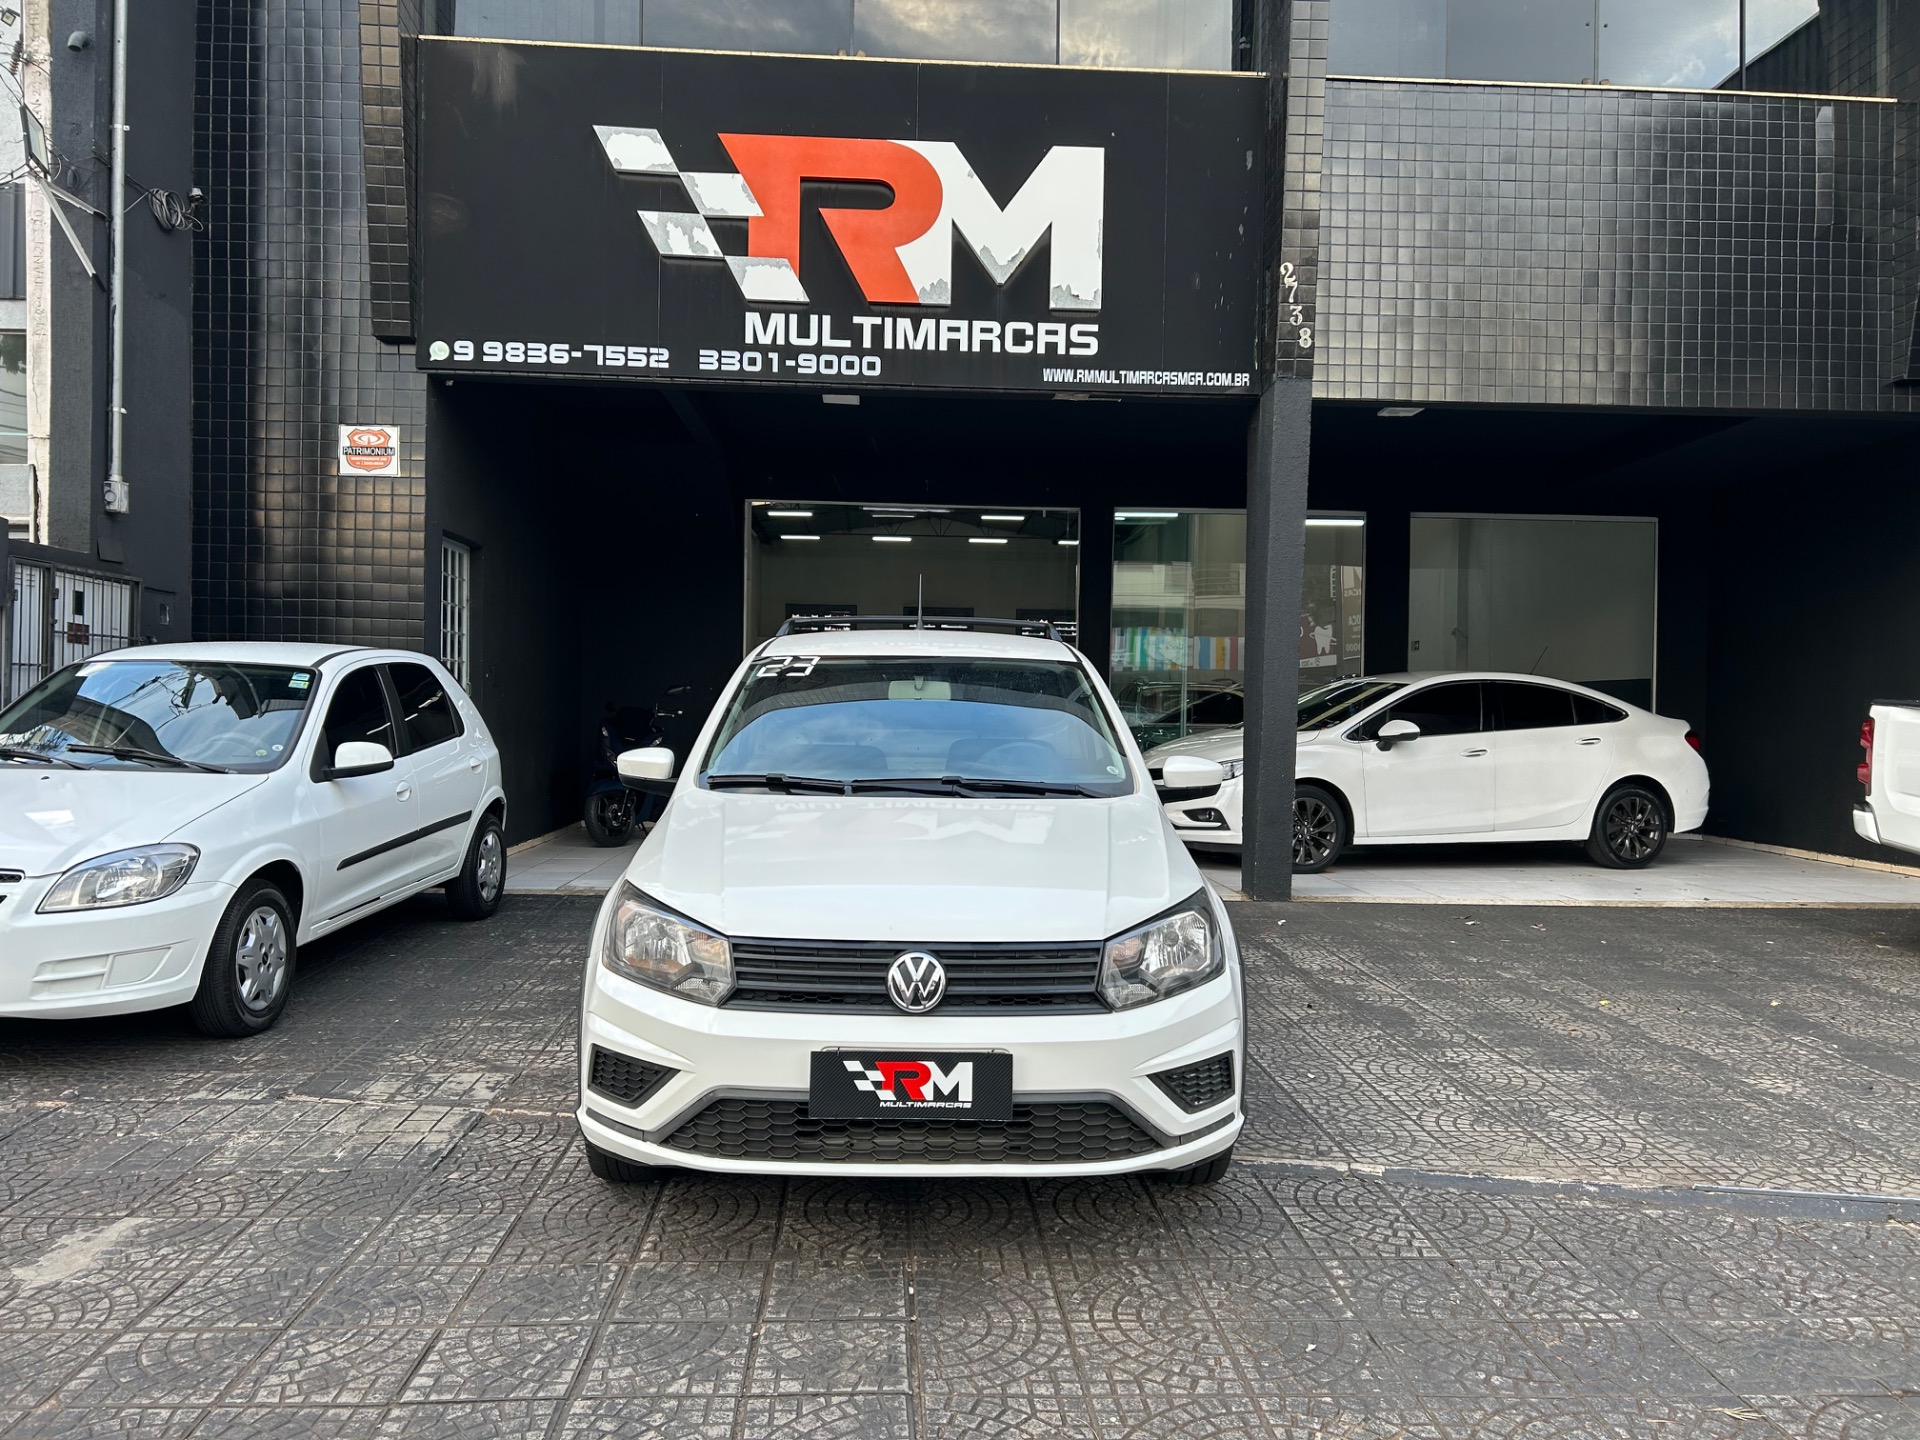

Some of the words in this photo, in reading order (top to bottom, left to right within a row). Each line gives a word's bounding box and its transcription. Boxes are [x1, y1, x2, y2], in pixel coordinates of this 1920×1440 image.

[717, 133, 1105, 311] RM
[1280, 262, 1312, 348] 2738
[744, 311, 1099, 356] MULTIMARCAS
[454, 341, 474, 361] 9
[483, 342, 669, 368] 9836-7552
[699, 350, 881, 376] 3301-9000
[343, 447, 395, 456] PATRIMONIUM
[756, 656, 821, 677] 23
[875, 1060, 973, 1102] RM
[879, 1101, 973, 1109] MULTIMARCAS
